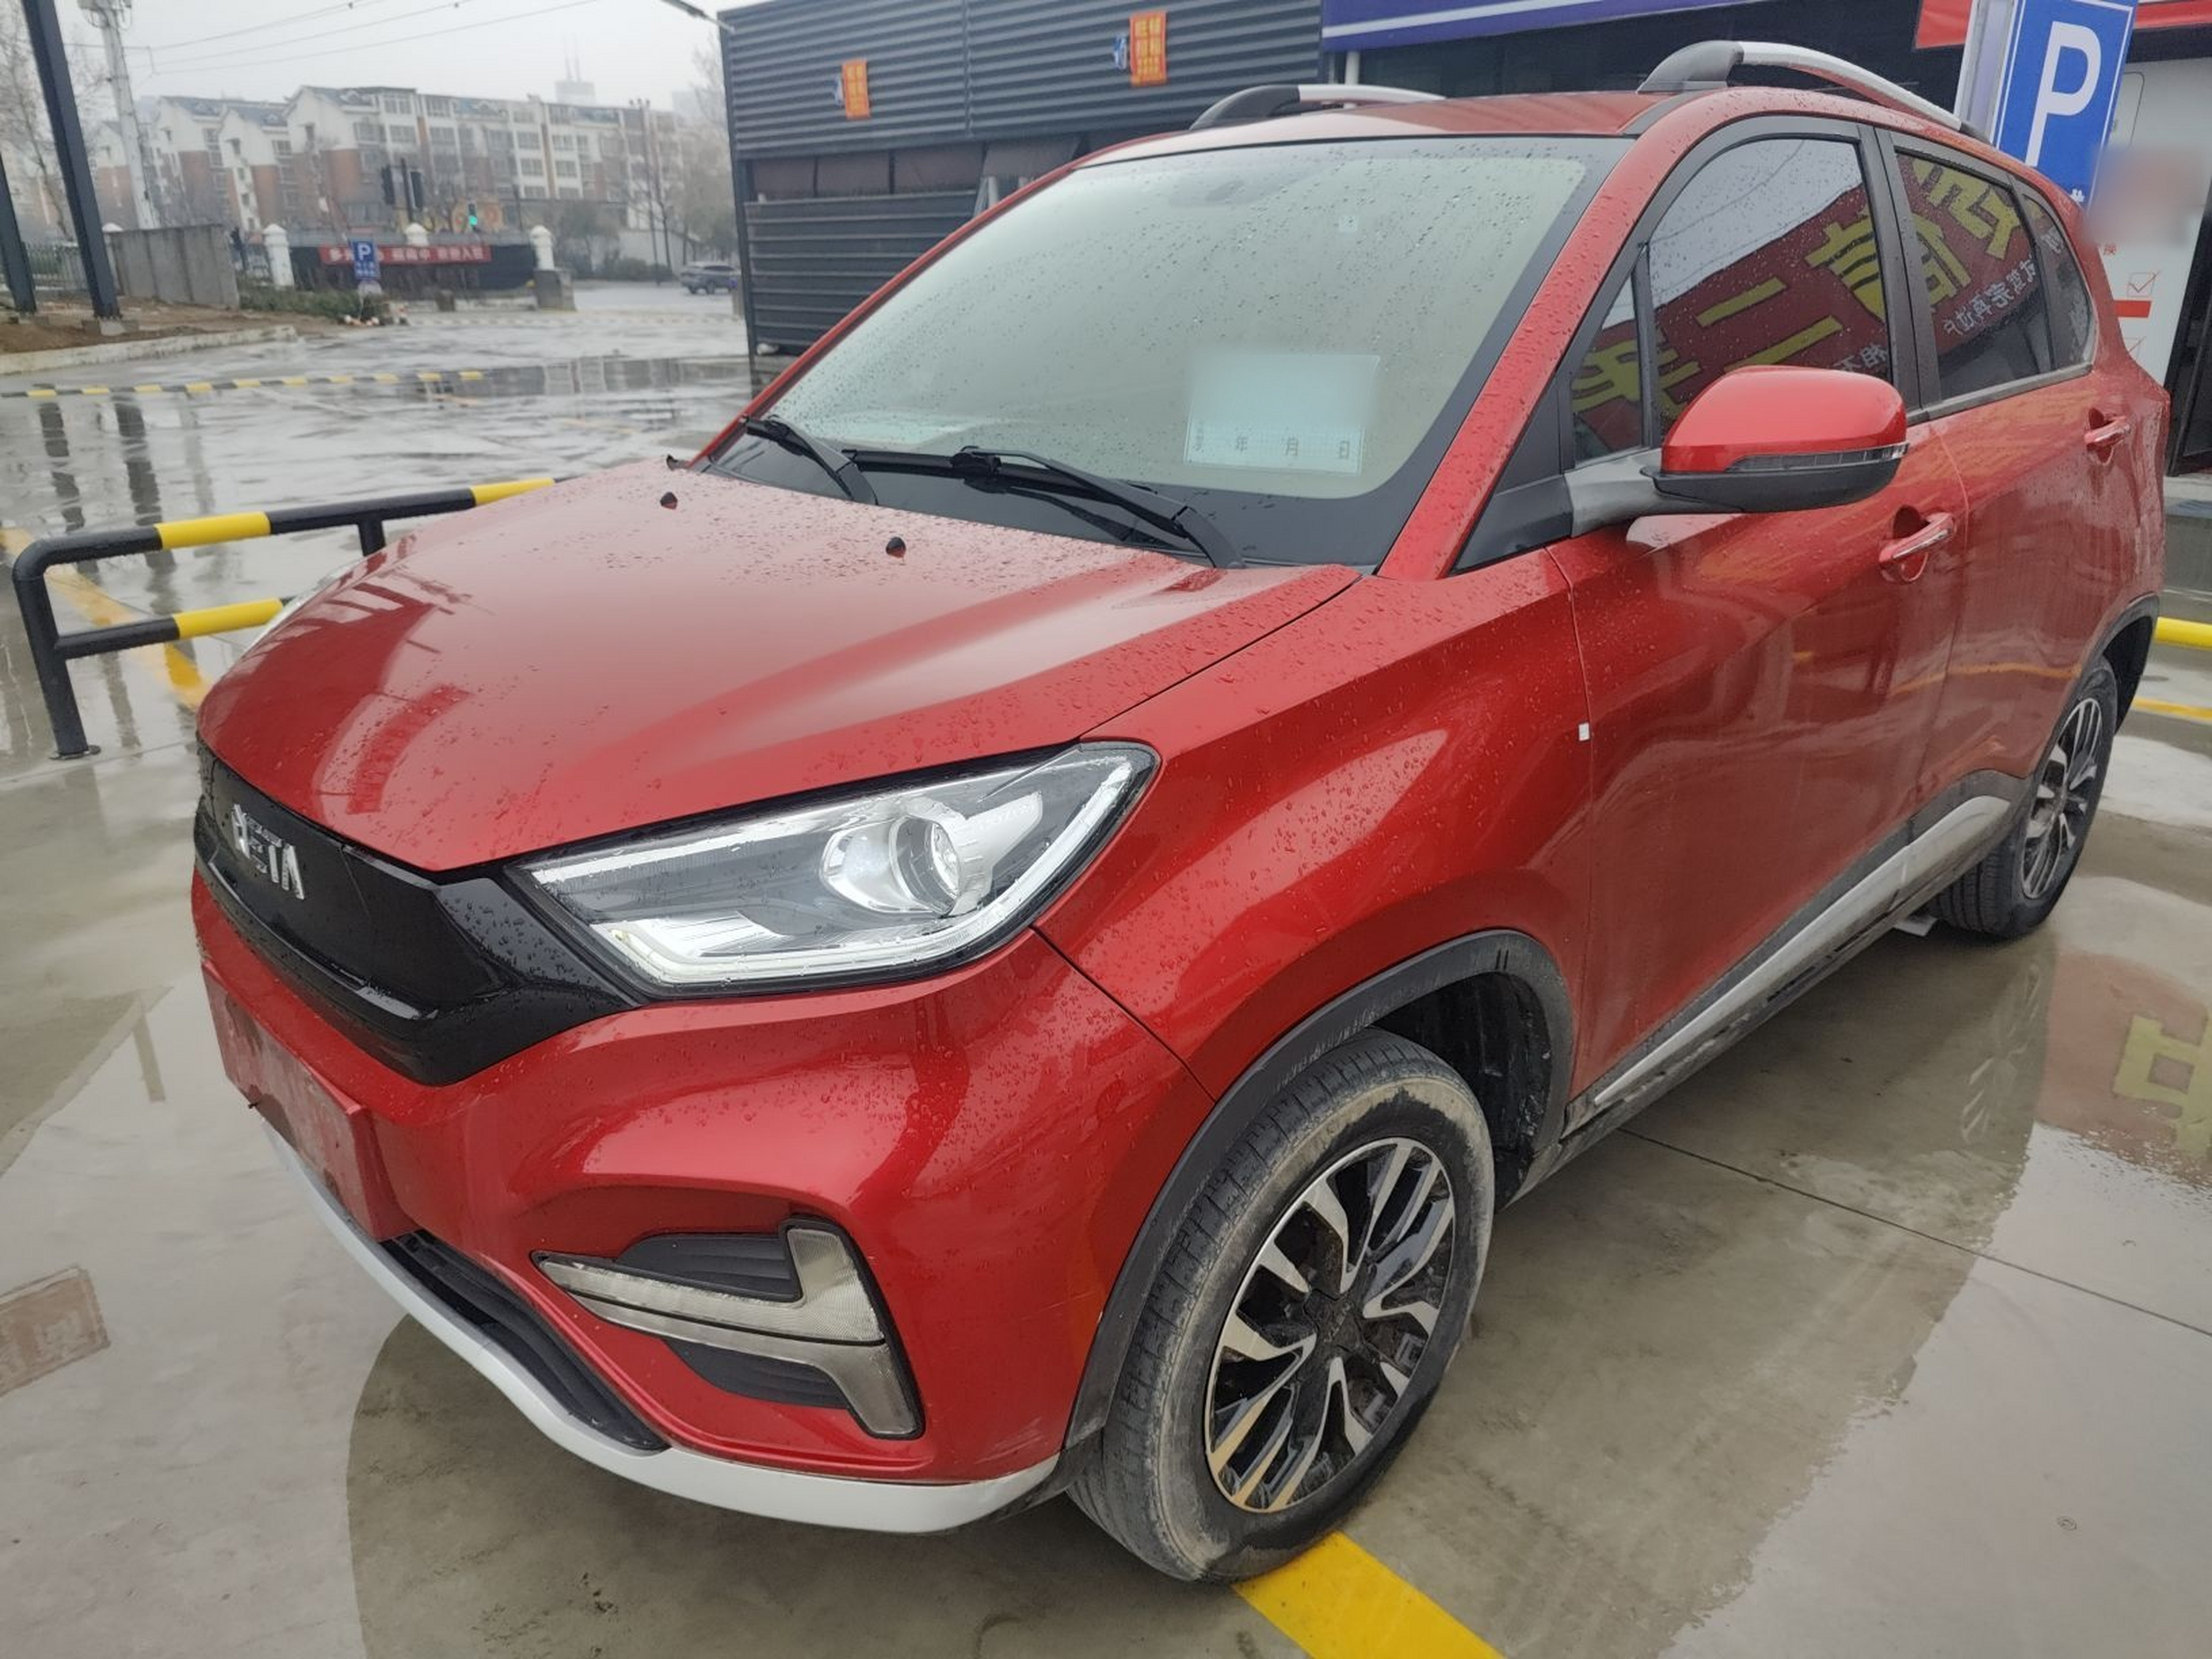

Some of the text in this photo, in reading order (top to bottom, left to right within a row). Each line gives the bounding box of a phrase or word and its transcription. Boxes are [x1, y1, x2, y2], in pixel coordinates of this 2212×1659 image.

[2025, 21, 2101, 166] P
[358, 243, 371, 260] P
[1236, 435, 1350, 459] 年 月 日
